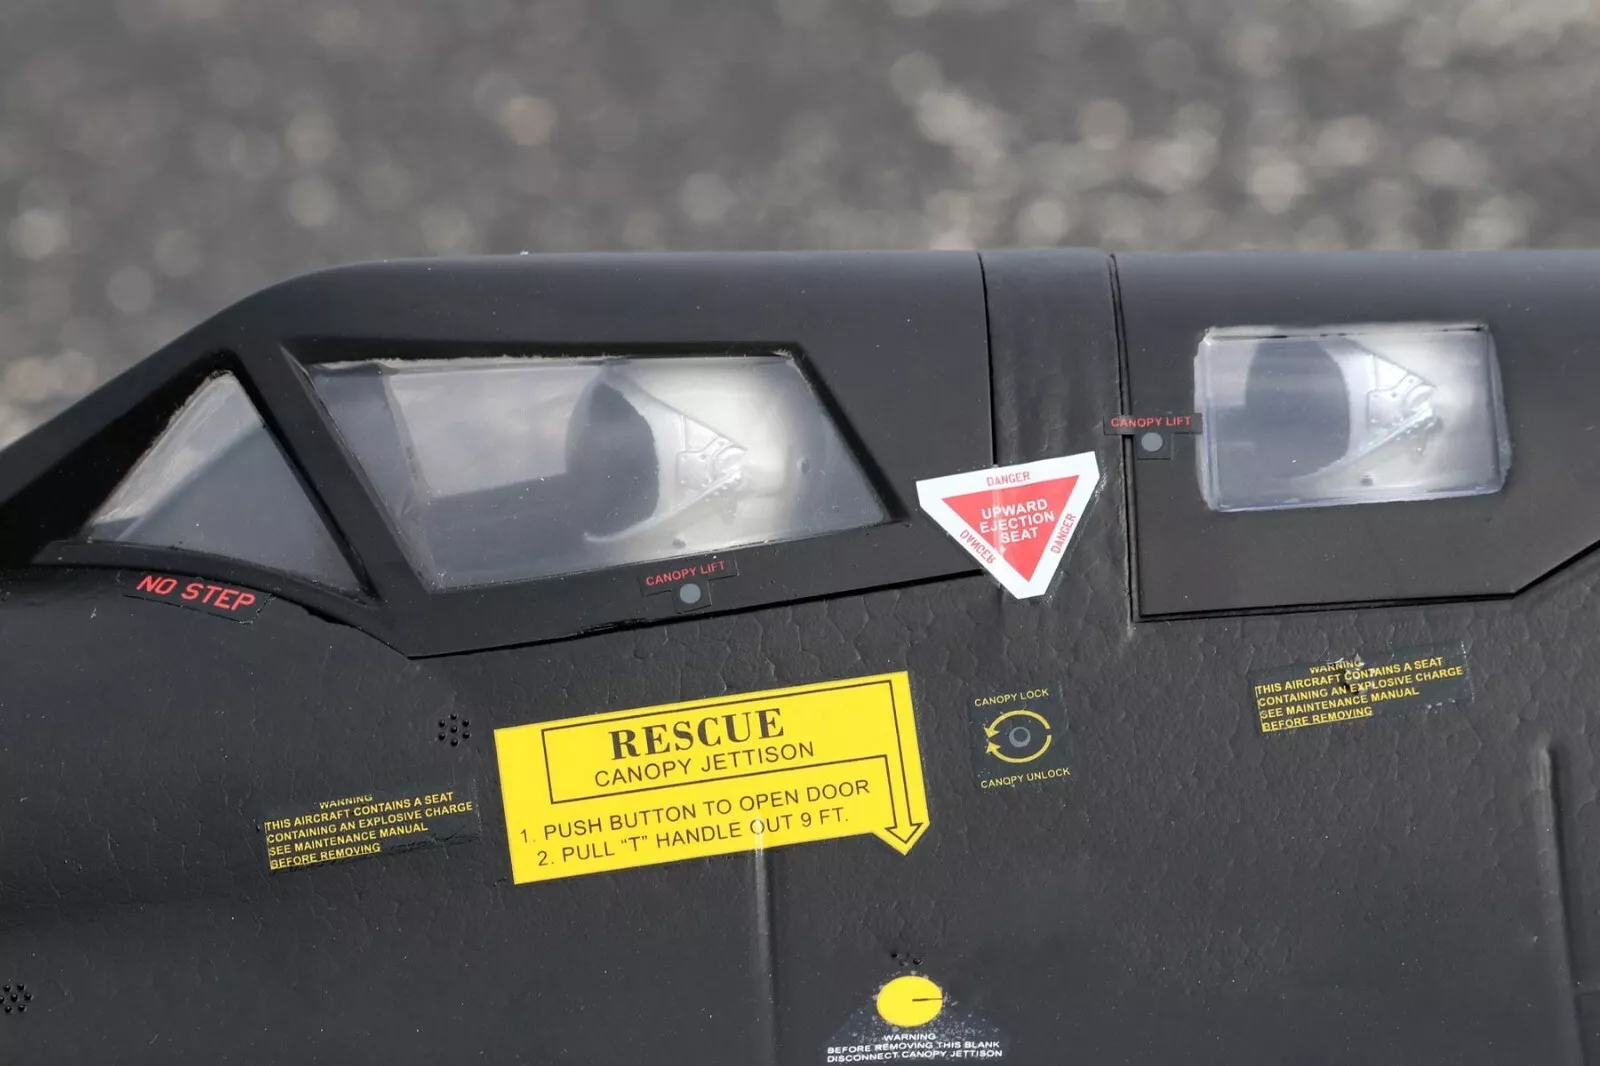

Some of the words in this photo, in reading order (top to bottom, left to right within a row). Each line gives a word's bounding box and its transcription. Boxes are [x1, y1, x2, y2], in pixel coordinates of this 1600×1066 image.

[1111, 417, 1163, 427] CANOPY
[1166, 416, 1191, 426] LIFT
[987, 471, 1030, 487] DANGER
[980, 511, 1054, 533] EJECTION
[981, 499, 1048, 519] UPWARD
[1000, 527, 1038, 544] SEAT
[1051, 513, 1076, 554] DANGER
[646, 567, 696, 586] CANOPY
[700, 561, 725, 574] LIFT
[136, 575, 178, 595] NO
[181, 582, 256, 611] STEP
[1256, 684, 1282, 695] THIS
[1285, 675, 1340, 692] AIRCRAFT
[1344, 664, 1401, 681] CONTAINS
[1404, 662, 1412, 671] A
[1414, 657, 1444, 669] SEAT
[1258, 689, 1328, 707] CONTAINING
[1331, 686, 1347, 697] AN
[1350, 675, 1412, 693] EXPLOSIVE
[1415, 666, 1463, 682] CHARGE
[974, 693, 1017, 706] CANOPY
[1020, 688, 1049, 700] LOCK
[1260, 708, 1282, 719] SEE
[1286, 696, 1368, 715] MAINTENANCE
[1371, 687, 1419, 702] MANUAL
[1262, 716, 1309, 732] BEFORE
[1312, 707, 1373, 724] REMOVING
[609, 708, 784, 761] RESCUE
[594, 758, 692, 787] CANOPY
[701, 741, 814, 772] JETTISON
[981, 775, 1023, 788] CANOPY
[1026, 767, 1070, 781] UNLOCK
[266, 819, 291, 831] THIS
[294, 810, 350, 826] AIRCRAFT
[354, 799, 411, 816] CONTAINS
[414, 797, 422, 806] A
[424, 792, 454, 804] SEAT
[267, 824, 337, 843] CONTAINING
[340, 822, 355, 832] AN
[359, 810, 422, 828] EXPLOSIVE
[425, 802, 473, 817] CHARGE
[521, 829, 536, 844] 1.
[544, 818, 602, 839] PUSH
[611, 805, 696, 831] BUTTON
[703, 799, 732, 816] TO
[739, 789, 799, 812] OPEN
[807, 779, 870, 802] DOOR
[269, 844, 291, 856] SEE
[294, 832, 376, 852] MAINTENANCE
[379, 822, 428, 838] MANUAL
[538, 850, 555, 866] 2.
[562, 841, 615, 862] PULL
[657, 823, 741, 848] HANDLE
[750, 815, 793, 835] OUT
[802, 811, 812, 827] 9
[820, 807, 849, 824] FT.
[270, 853, 316, 869] BEFORE
[320, 843, 381, 861] REMOVING
[827, 1045, 871, 1054] BEFORE
[875, 1042, 933, 1051] REMOVING
[827, 1051, 899, 1063] DISCONNECT
[902, 1050, 947, 1059] CANOPY
